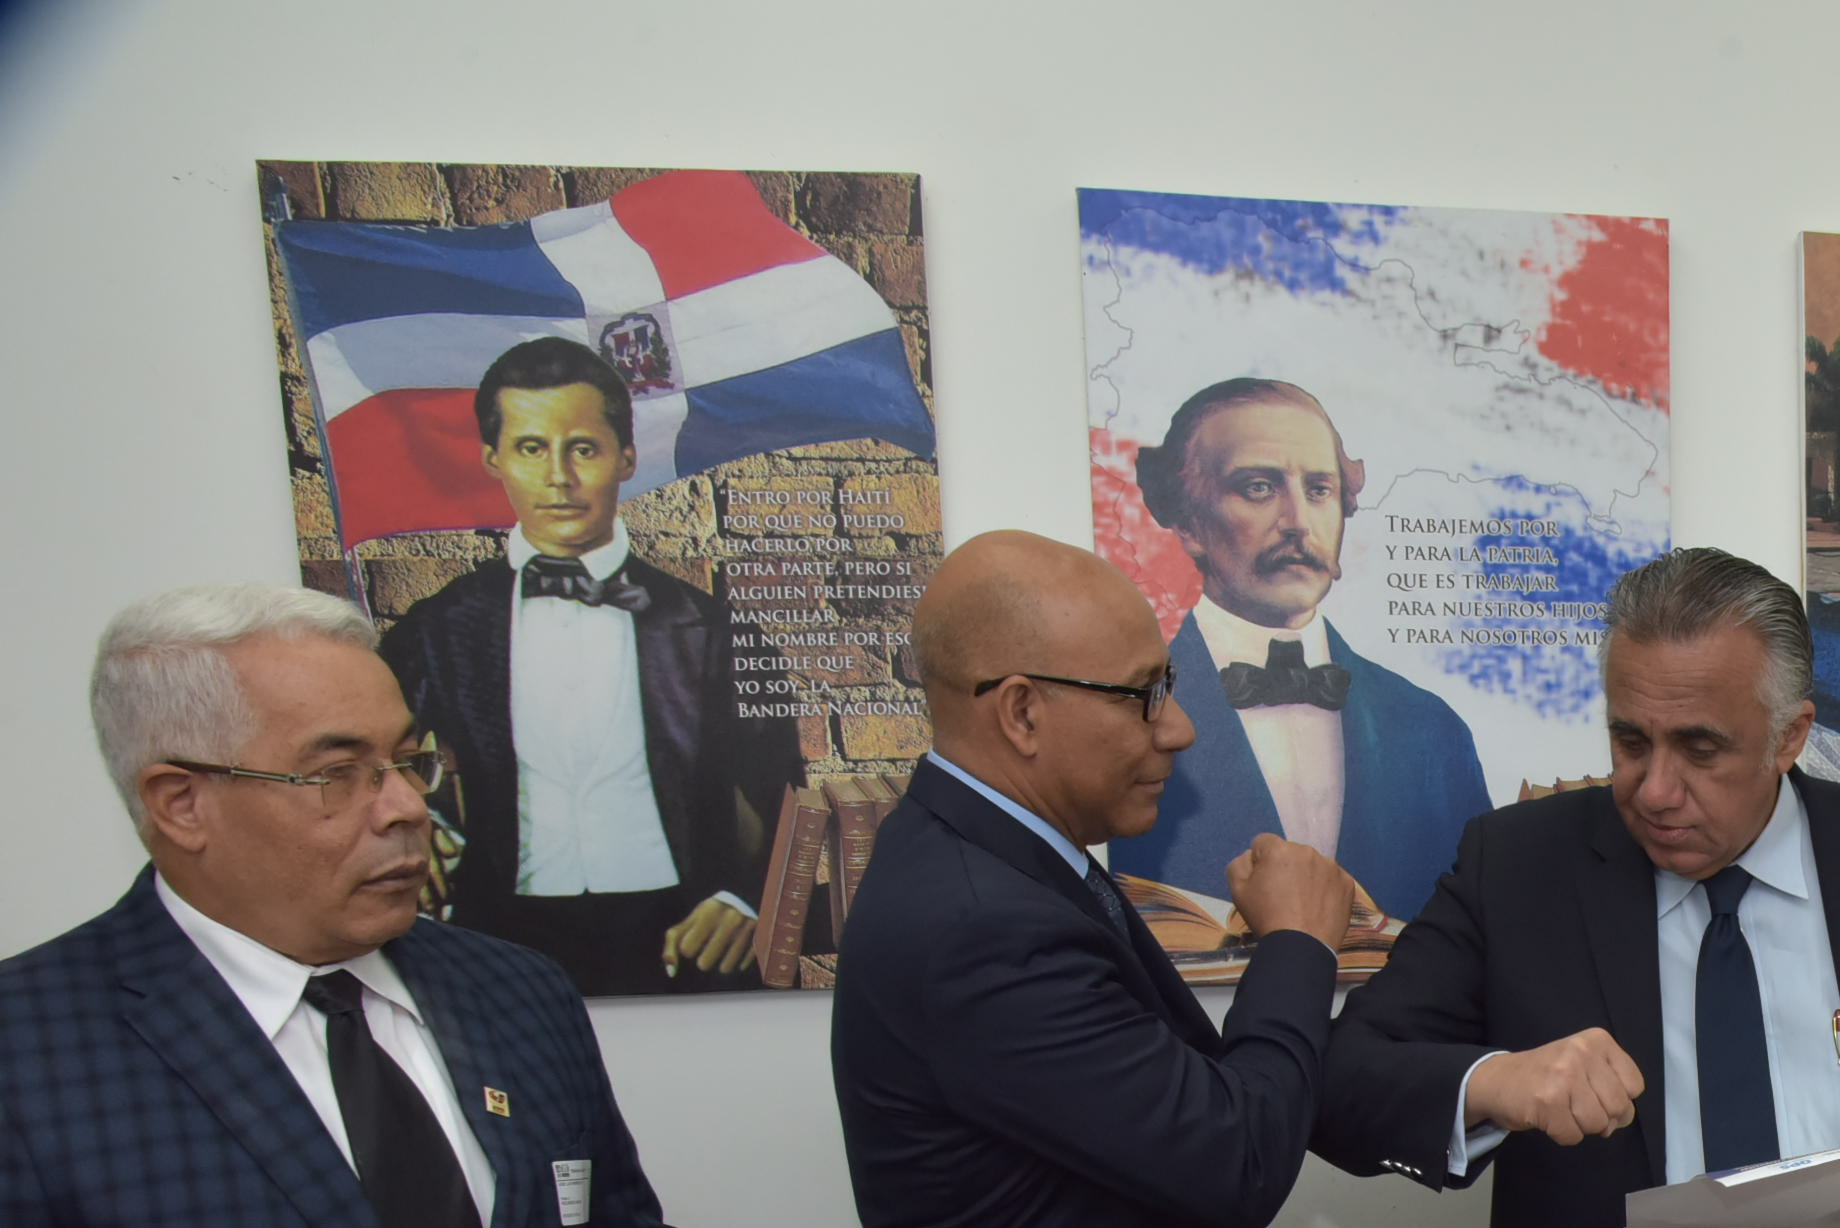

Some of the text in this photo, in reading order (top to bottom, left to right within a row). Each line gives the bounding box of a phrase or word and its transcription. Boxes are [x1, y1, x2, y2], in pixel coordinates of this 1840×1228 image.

[797, 490, 834, 505] POR
[838, 488, 888, 504] HAITÍ
[723, 514, 904, 531] POR QUE NO PUEDO
[1385, 515, 1561, 537] TRABAJEMOS POR
[816, 538, 854, 552] POR
[1385, 544, 1559, 565] Y PARA LA PATRIA,
[726, 562, 911, 577] OTRA PARTE, PERO SI
[1387, 573, 1559, 594] QUE ES TRABAJAR
[727, 585, 806, 600] ALGUIEN
[730, 608, 835, 624] MANCILLAR
[1388, 601, 1608, 622] PARA NUESTROS HIJOS
[732, 633, 755, 648] MI
[761, 632, 838, 647] NOMBRE
[844, 632, 881, 646] POR
[1387, 628, 1399, 644] Y
[1407, 629, 1454, 644] PARA
[1460, 630, 1568, 646] NOSOTROS
[734, 655, 854, 673] DECIDLE QUE
[734, 680, 760, 695] YO
[811, 678, 832, 692] LA
[737, 701, 823, 718] BANDERA
